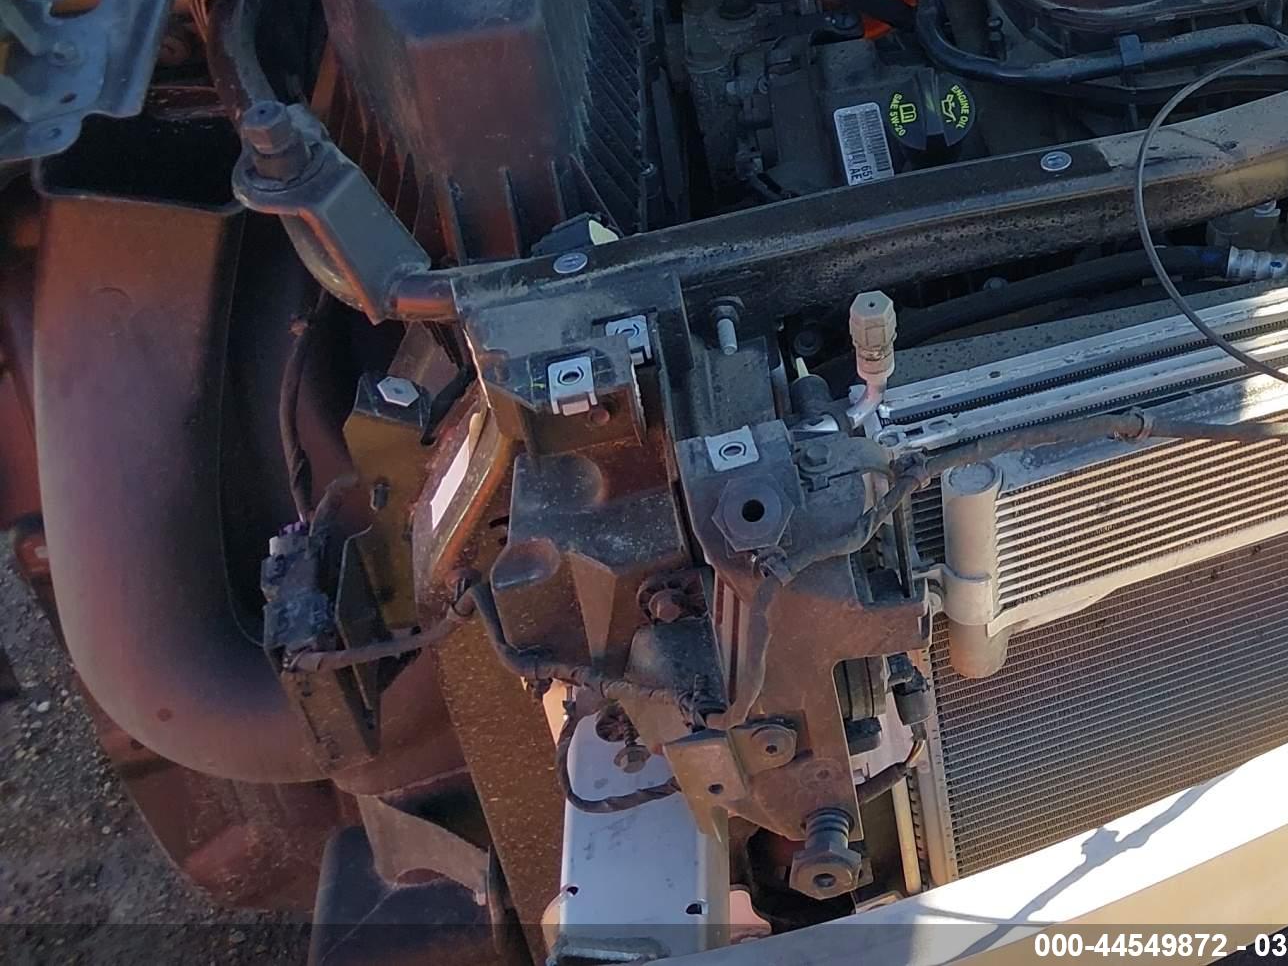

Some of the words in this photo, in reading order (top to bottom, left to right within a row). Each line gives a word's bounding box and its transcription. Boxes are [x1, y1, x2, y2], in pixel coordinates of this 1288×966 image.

[890, 93, 903, 110] SAE
[951, 84, 970, 115] ENGINE
[889, 111, 907, 138] 5W-20
[955, 116, 969, 130] OIL
[849, 167, 863, 181] AE
